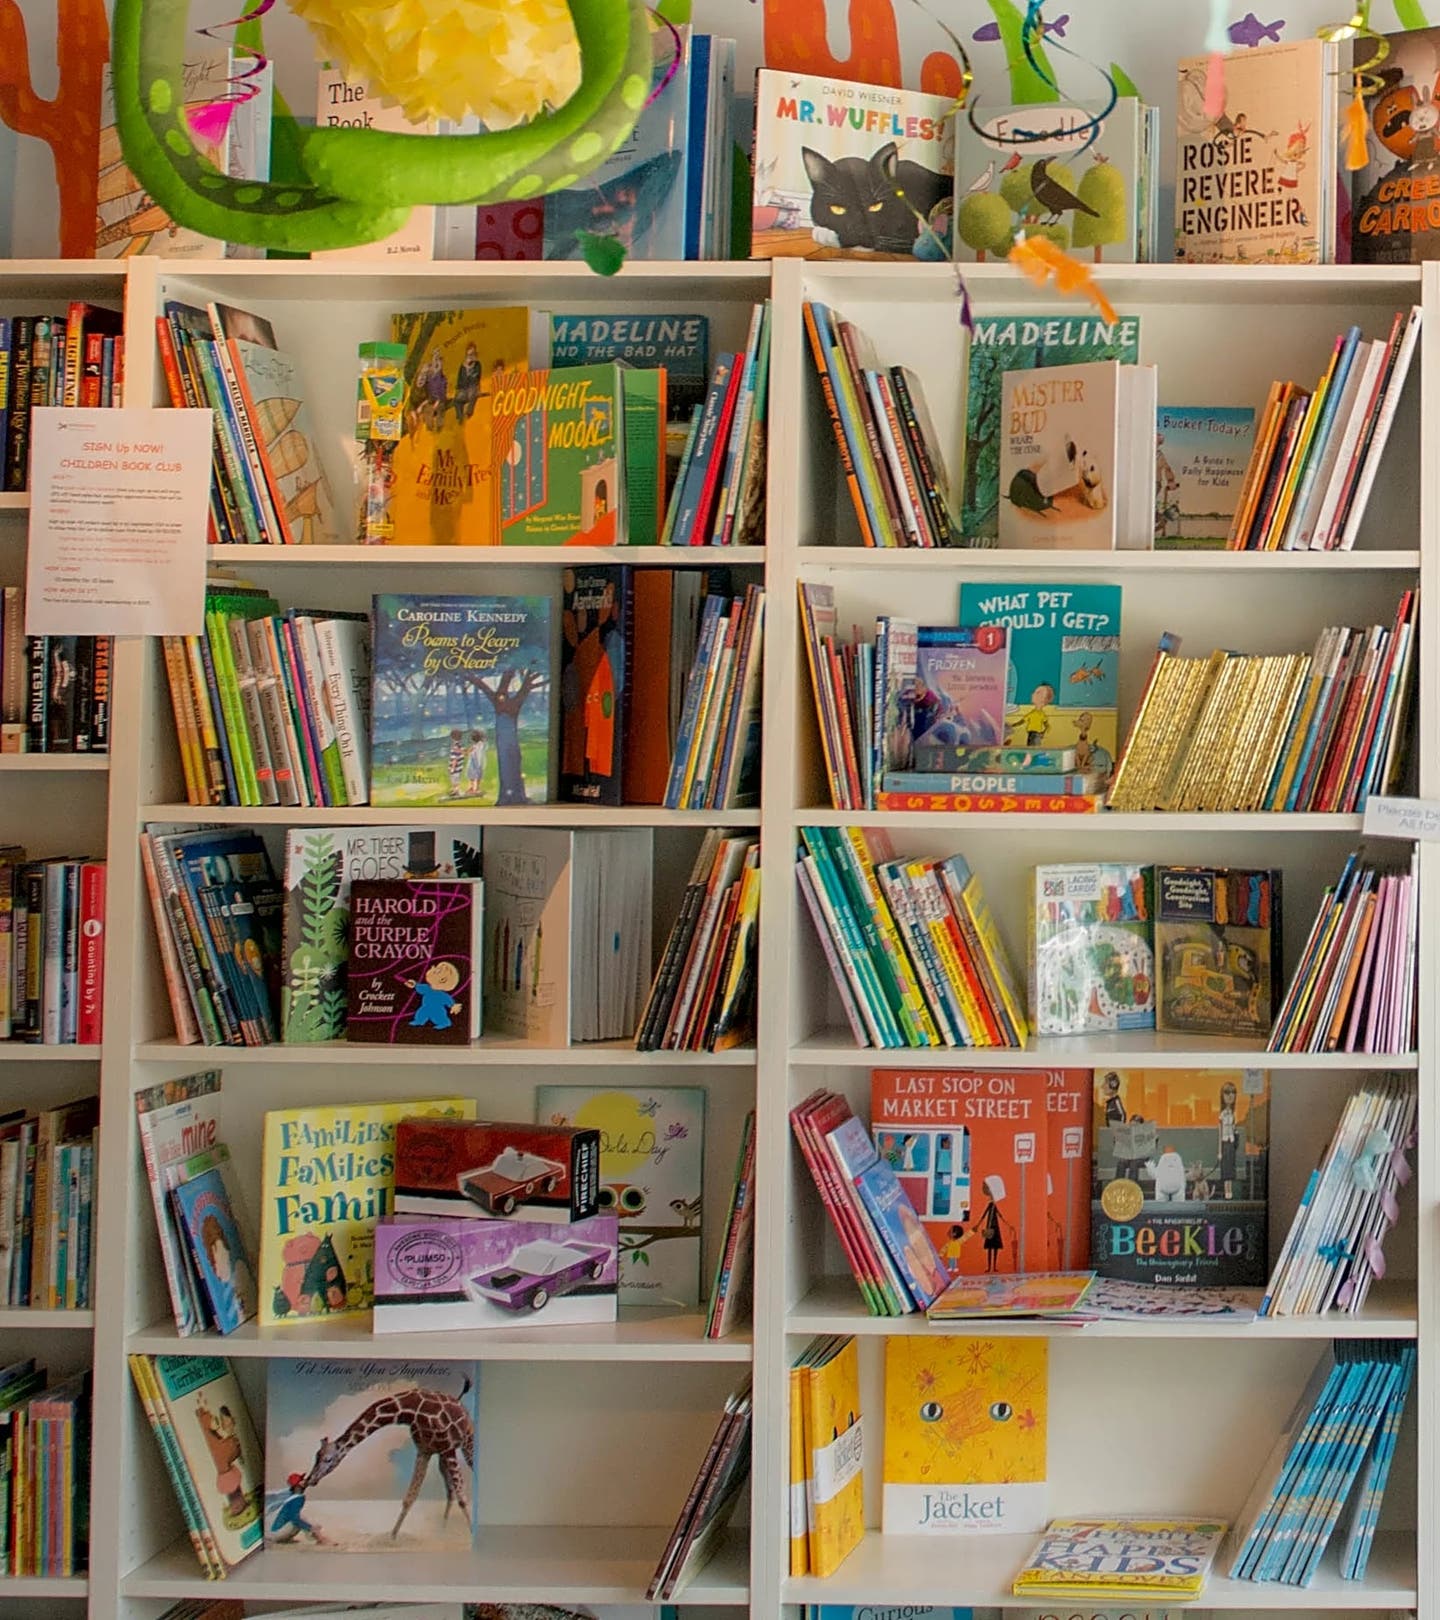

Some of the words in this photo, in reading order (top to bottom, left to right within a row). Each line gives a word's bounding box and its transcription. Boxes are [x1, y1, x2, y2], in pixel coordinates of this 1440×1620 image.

[328, 83, 364, 104] The
[822, 85, 855, 99] DAVID
[858, 90, 903, 105] WIESNER
[327, 112, 373, 130] Book
[776, 97, 823, 124] MR.
[827, 104, 945, 143] WUFFLES!
[996, 116, 1090, 148] Frodle
[1183, 137, 1253, 172] ROSIE
[1183, 168, 1283, 203] REVERE,
[1182, 199, 1302, 236] ENGINEER
[552, 320, 700, 342] MADELINE
[971, 321, 1137, 347] MADELINE
[586, 345, 616, 357] THE
[624, 345, 656, 357] BAD
[664, 345, 696, 357] HAT
[492, 380, 592, 416] GOODNIGHT
[229, 380, 246, 417] NELSON
[239, 415, 256, 454] MANDELA
[822, 376, 839, 421] CREEPY
[832, 421, 853, 475] CARROTS!
[1009, 410, 1047, 436] BUD
[1163, 416, 1202, 432] Bucket
[1206, 418, 1250, 437] Today?
[549, 419, 605, 450] MOON
[83, 442, 112, 452] SIGN
[116, 443, 130, 453] Up
[133, 443, 164, 454] NOW!
[60, 459, 118, 471] CHILDREN
[121, 461, 151, 472] BOOK
[155, 462, 182, 473] CLUB
[437, 449, 455, 468] My
[1193, 456, 1200, 465] A
[1212, 477, 1230, 487] Kids
[978, 592, 1030, 616] WHAT
[1037, 591, 1073, 609] PET
[397, 608, 461, 622] CAROLINE
[467, 609, 527, 623] KENNEDY
[1062, 612, 1110, 631] GET?
[402, 622, 457, 648] Poems
[460, 632, 475, 648] to
[474, 626, 520, 654] Learn
[986, 633, 994, 645] 1
[423, 648, 441, 676] by
[442, 648, 498, 670] Heart
[927, 658, 976, 672] FROZEN
[32, 663, 44, 722] TESTING
[327, 672, 344, 700] Every
[332, 699, 349, 731] Thing
[951, 775, 1017, 793] PEOPLE
[906, 796, 1066, 812] SEASONS
[1377, 804, 1421, 819] Please
[1419, 820, 1438, 831] for
[347, 837, 367, 856] MR.
[370, 836, 405, 856] TIGER
[350, 856, 401, 880] GOES
[1163, 876, 1204, 889] Goodnight,
[355, 898, 437, 914] HAROLD
[1165, 893, 1210, 903] Construction
[1178, 901, 1193, 910] Site
[355, 915, 376, 926] and
[377, 915, 392, 926] the
[355, 926, 430, 943] PURPLE
[354, 943, 435, 960] CRAYON
[85, 940, 96, 986] counting
[85, 988, 96, 999] by
[371, 977, 382, 992] by
[358, 990, 396, 1002] Crockett
[358, 1001, 393, 1015] Johnson
[895, 1077, 938, 1095] LAST
[942, 1077, 982, 1095] STOP
[988, 1078, 1016, 1095] ON
[883, 1097, 959, 1118] MARKET
[964, 1098, 1034, 1119] STREET
[180, 1117, 217, 1153] mine
[632, 1131, 670, 1165] Day
[579, 1142, 591, 1213] FIRECHIEF
[274, 1187, 396, 1237] Famil
[1195, 1257, 1219, 1266] Friend
[1155, 1274, 1172, 1283] Dan
[319, 1362, 354, 1377] Know
[359, 1362, 387, 1378] You
[939, 1490, 959, 1503] The
[919, 1492, 1005, 1525] Jacket
[1070, 1522, 1104, 1543] 7
[1093, 1528, 1213, 1541] HABITS
[1040, 1541, 1207, 1556] HAPPY
[1031, 1553, 1200, 1576] KIDS
[857, 1605, 934, 1620] Curious
